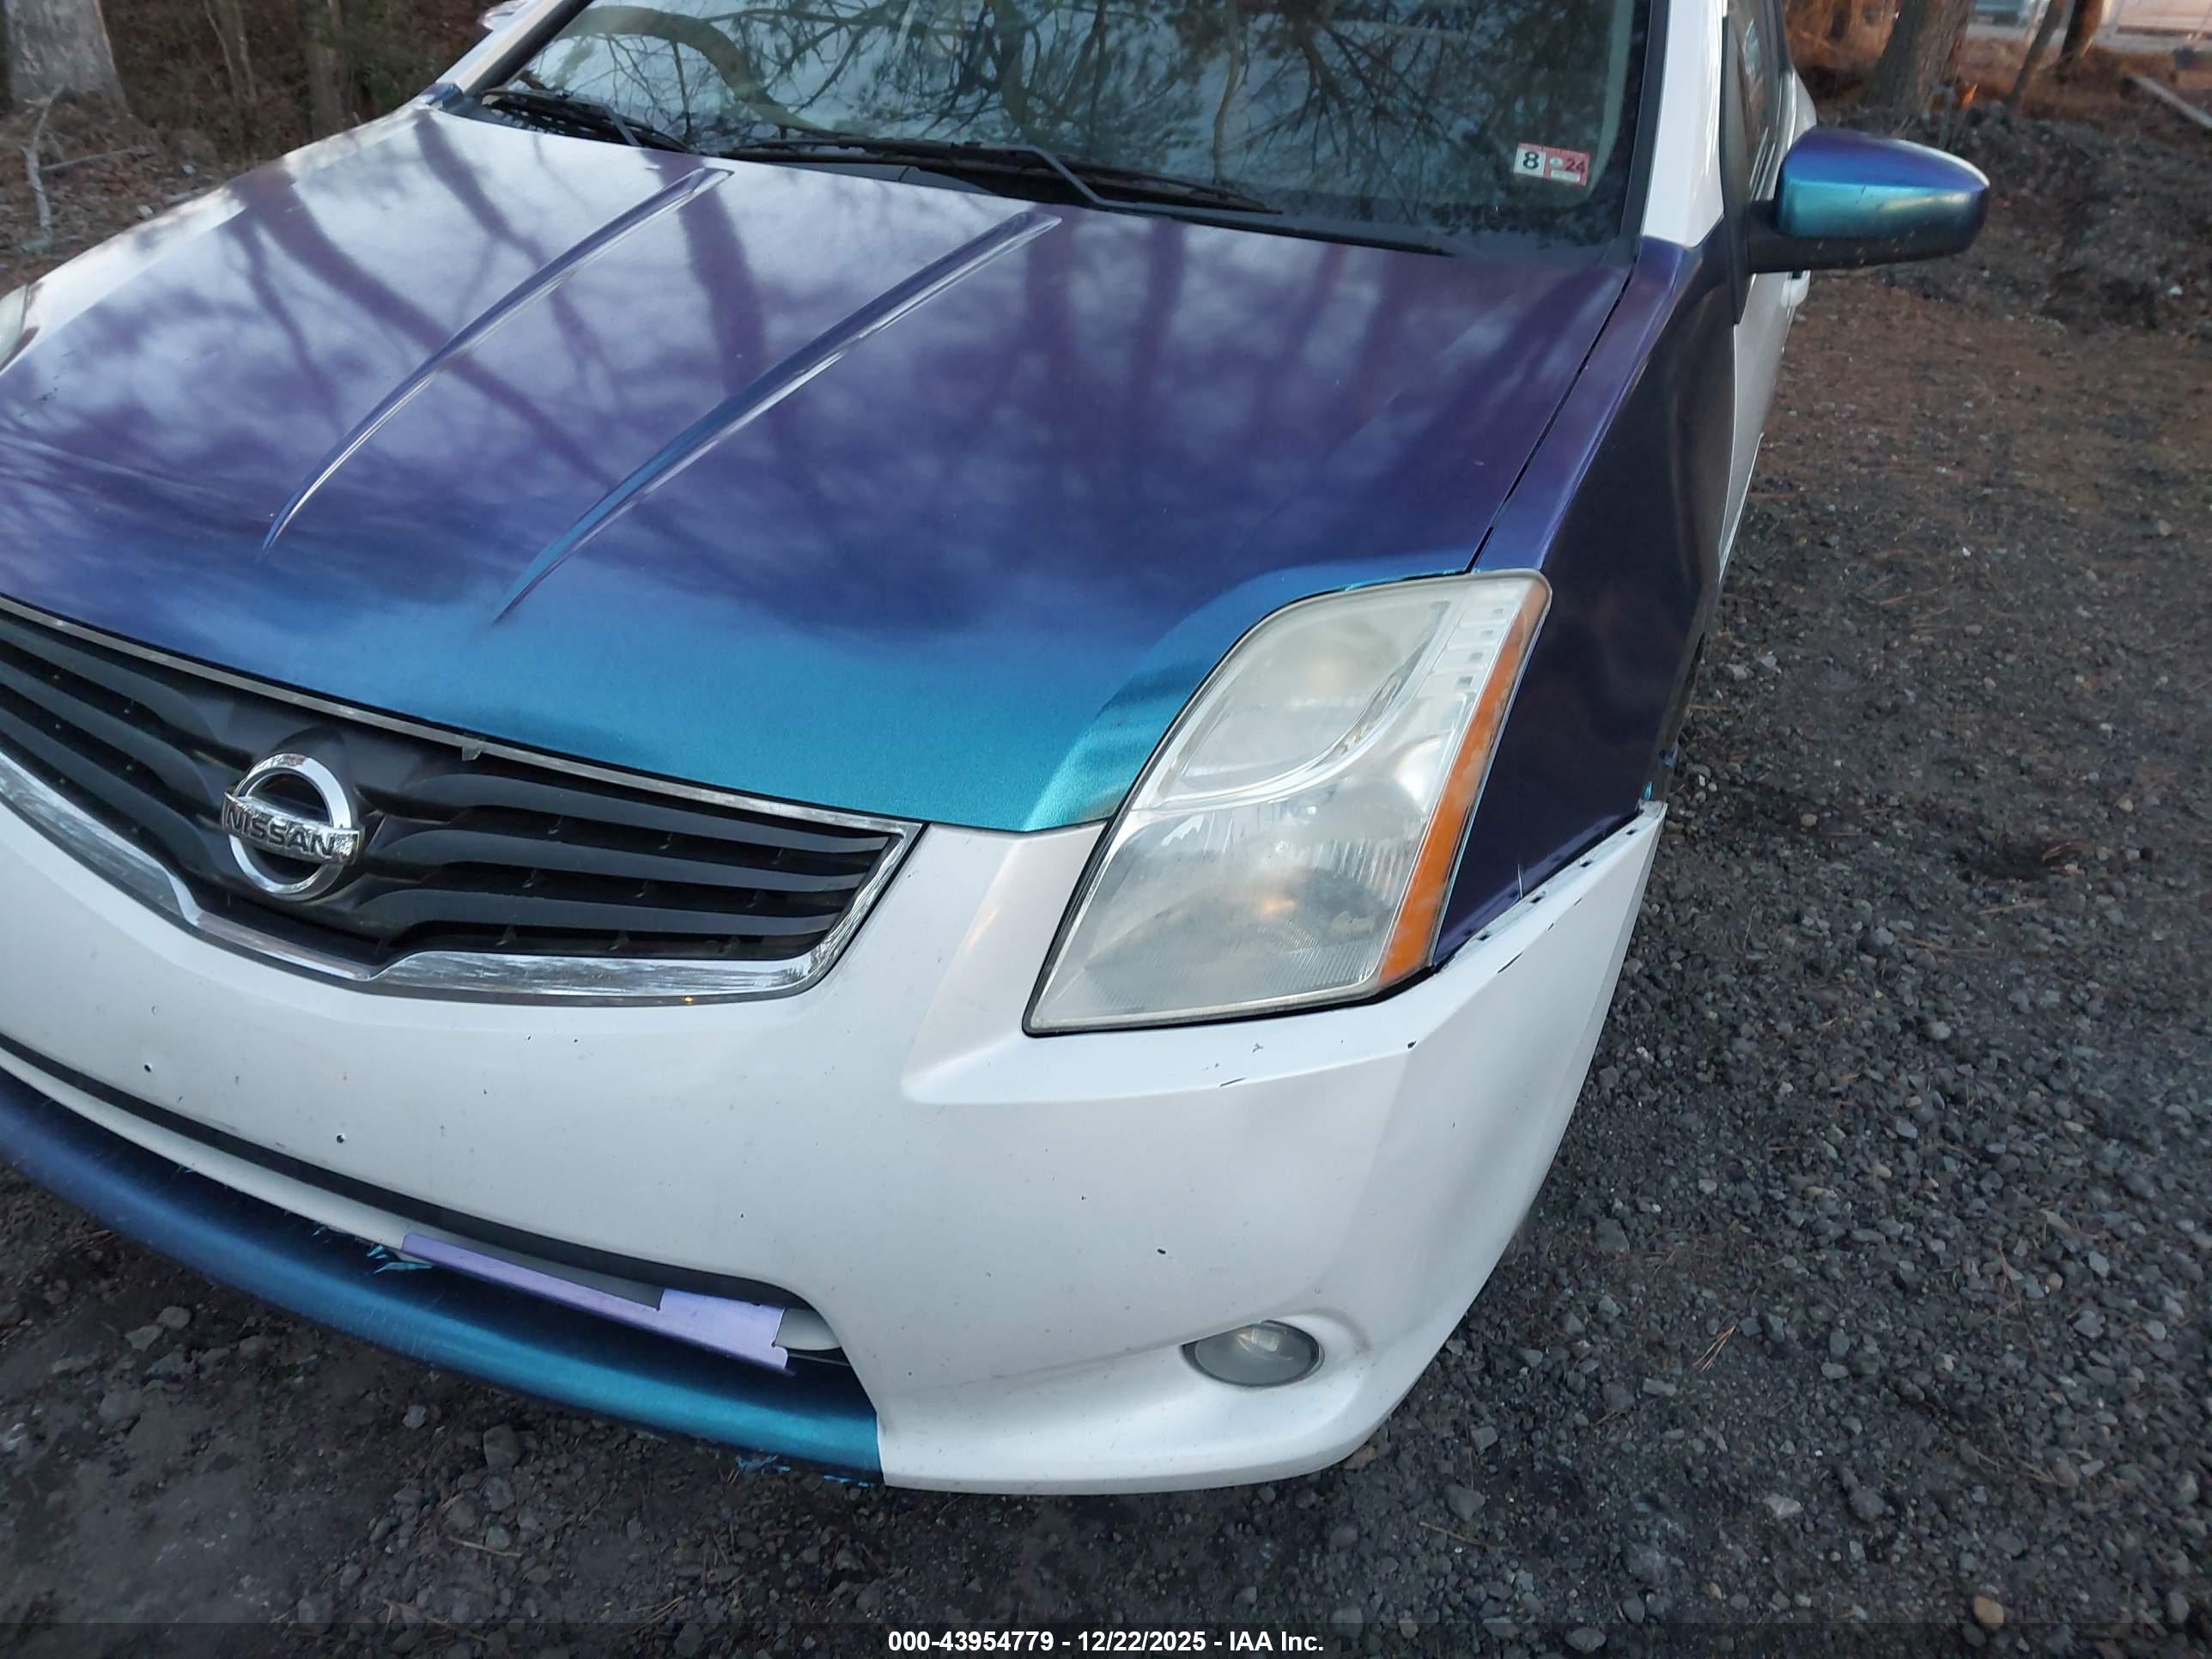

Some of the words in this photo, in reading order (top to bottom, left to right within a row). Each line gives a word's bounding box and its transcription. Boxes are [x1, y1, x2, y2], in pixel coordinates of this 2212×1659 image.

[1523, 151, 1540, 170] 8
[1565, 157, 1585, 173] 24
[225, 800, 335, 855] NISSAN
